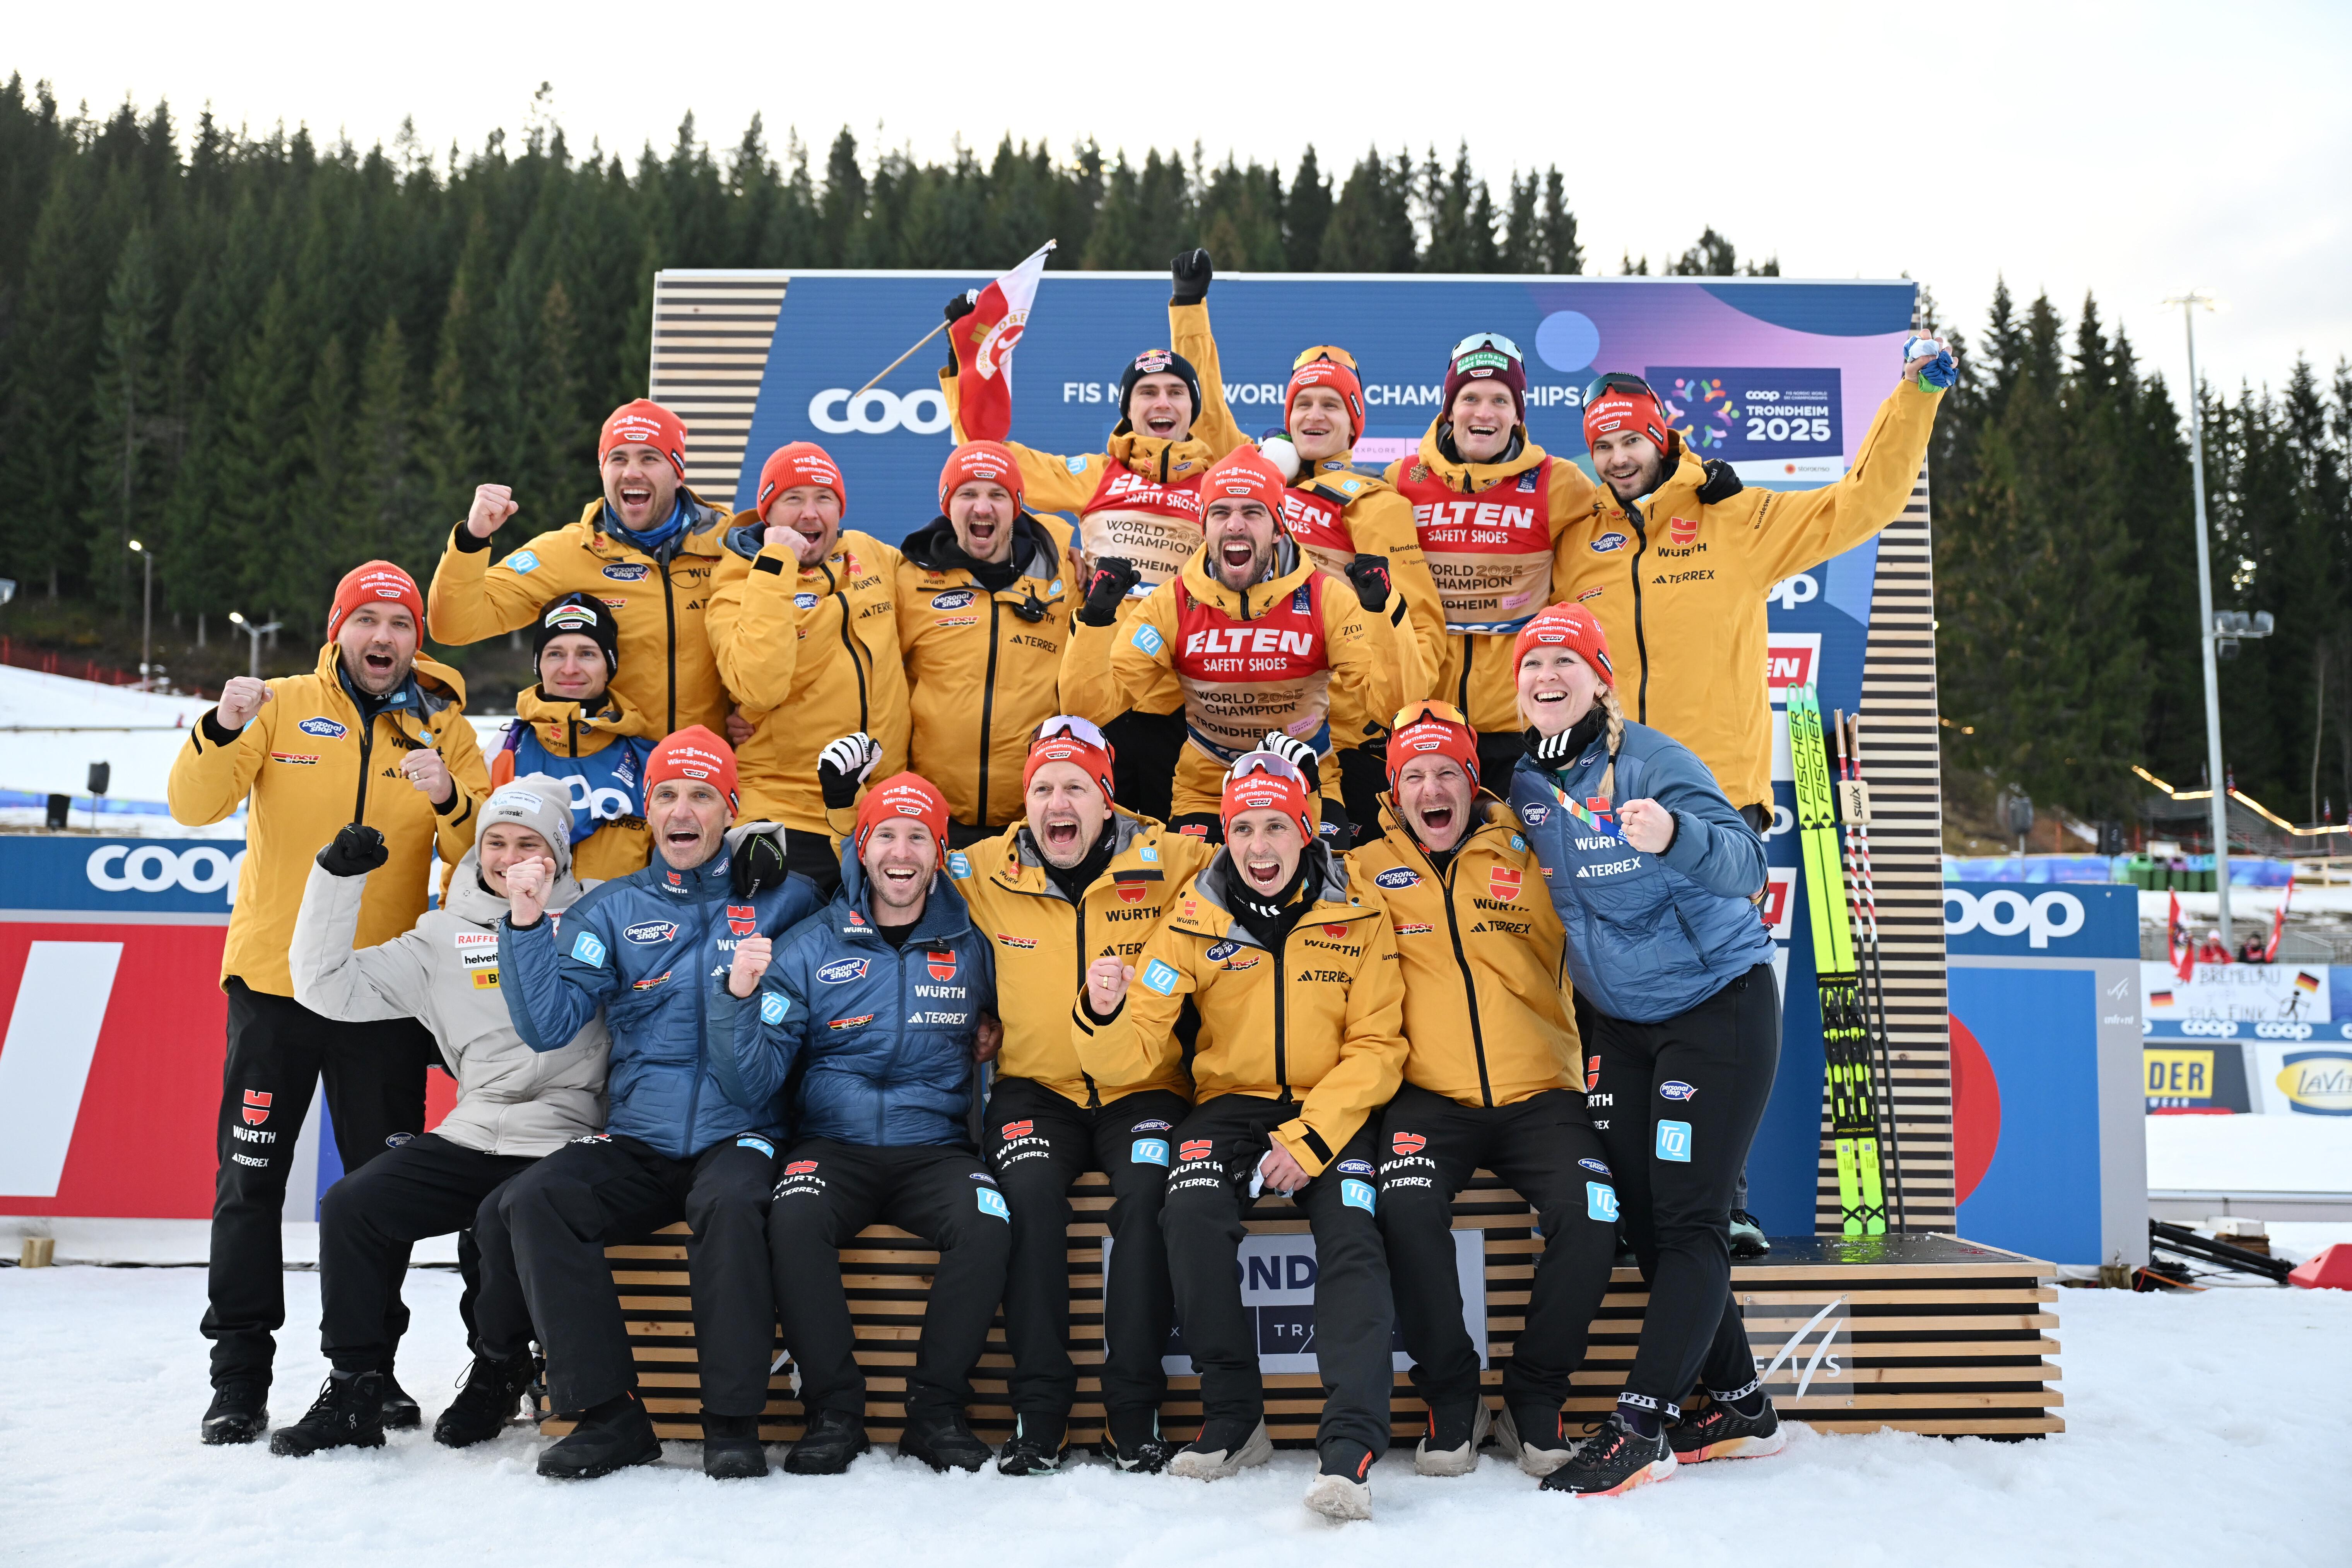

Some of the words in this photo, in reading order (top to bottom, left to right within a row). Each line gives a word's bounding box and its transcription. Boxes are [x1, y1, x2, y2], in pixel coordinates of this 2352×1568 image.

[1135, 358, 1152, 370] Red
[1457, 353, 1507, 367] Kräuterhaus
[1457, 360, 1474, 373] Sanct
[1476, 359, 1507, 369] Bernhard
[1064, 383, 1101, 403] FIS
[1222, 384, 1287, 404] WORL
[1745, 391, 1780, 402] coop
[808, 388, 957, 446] coo
[1746, 405, 1828, 416] TRONDHEIM
[1588, 411, 1632, 427] Wärmepumpen
[613, 426, 659, 436] Wärmepumpen
[1747, 418, 1831, 441] 2025
[961, 462, 1006, 474] Wärmepumpen
[1215, 477, 1264, 488] Wärmepumpen
[1124, 492, 1163, 504] SAFETY
[1412, 502, 1534, 528] ELTEN
[1754, 494, 1773, 529] Bundeswe
[1107, 520, 1164, 537] WORLD
[1428, 530, 1467, 542] SAFETY
[1472, 530, 1508, 543] SHOES
[1593, 534, 1622, 547] personal
[1113, 533, 1200, 556] CHAMPION
[1390, 544, 1421, 553] Bundes
[1598, 541, 1613, 550] shop
[1657, 542, 1707, 557] WÜRTH
[1476, 565, 1522, 576] 2025
[1668, 569, 1714, 584] TERREX
[361, 581, 410, 593] Wärmepumpen
[851, 575, 882, 591] WÜRTH
[934, 592, 969, 605] personal
[942, 599, 962, 608] shop
[871, 602, 892, 615] TERR
[955, 617, 977, 625] DSV
[1526, 626, 1579, 636] Wärmepumpen
[1024, 635, 1058, 655] TERREX
[1185, 628, 1312, 658] ELTEN
[1203, 658, 1244, 672] SAFETY
[1249, 657, 1287, 671] SHOES
[1194, 690, 1255, 704] WORLD
[1257, 689, 1304, 704] 2025
[1205, 701, 1296, 716] CHAMPION
[302, 720, 342, 732] personal
[310, 725, 332, 734] shop
[1193, 713, 1283, 738] TRONDHEIM
[1400, 733, 1452, 747] Wärmepumpen
[1035, 743, 1085, 757] Wärmepumpen
[1806, 710, 1829, 804] FISCHER
[292, 755, 320, 764] DSV
[1791, 710, 1812, 805] FISCHER
[667, 758, 720, 773] Wärmepumpen
[617, 768, 633, 781] 2025
[1234, 790, 1287, 801] Wärmepumpen
[882, 797, 932, 812] Wärmepumpen
[1525, 803, 1546, 817] personal
[1530, 812, 1540, 822] shop
[1575, 836, 1623, 850] WÜRT
[1589, 856, 1641, 877] TERREX
[999, 869, 1018, 886] WÜRTH
[1378, 868, 1417, 883] personal
[1386, 876, 1408, 885] shop
[662, 882, 687, 893] WÜRTH
[1106, 906, 1161, 922] WÜRTH
[1943, 888, 2085, 948] oop
[1176, 917, 1198, 926] WÜRTH
[1488, 921, 1531, 934] TERREX
[627, 923, 669, 937] personal
[636, 930, 660, 940] shop
[1118, 942, 1146, 956] TER
[1304, 939, 1361, 957] WÜRTH
[465, 952, 498, 964] helveti
[820, 960, 860, 977] personal
[829, 969, 852, 980] shop
[914, 986, 966, 999] WÜRTH
[924, 1012, 967, 1024] TERREX
[2181, 1019, 2238, 1039] coop
[2255, 1022, 2313, 1041] coop
[1661, 1084, 1689, 1093] personal
[1133, 1122, 1166, 1131] personal
[233, 1125, 277, 1144] WÜRTH
[996, 1137, 1050, 1160] WÜRTH
[238, 1153, 269, 1168] TERREX
[1011, 1151, 1049, 1163] TERREX
[1169, 1161, 1223, 1179] WÜRTH
[1340, 1163, 1372, 1171] personal
[1380, 1156, 1435, 1175] WÜRTH
[773, 1176, 826, 1193] WÜRTH
[1179, 1178, 1219, 1188] TERREX
[1391, 1177, 1432, 1188] TERREX
[781, 1187, 820, 1196] TERREX
